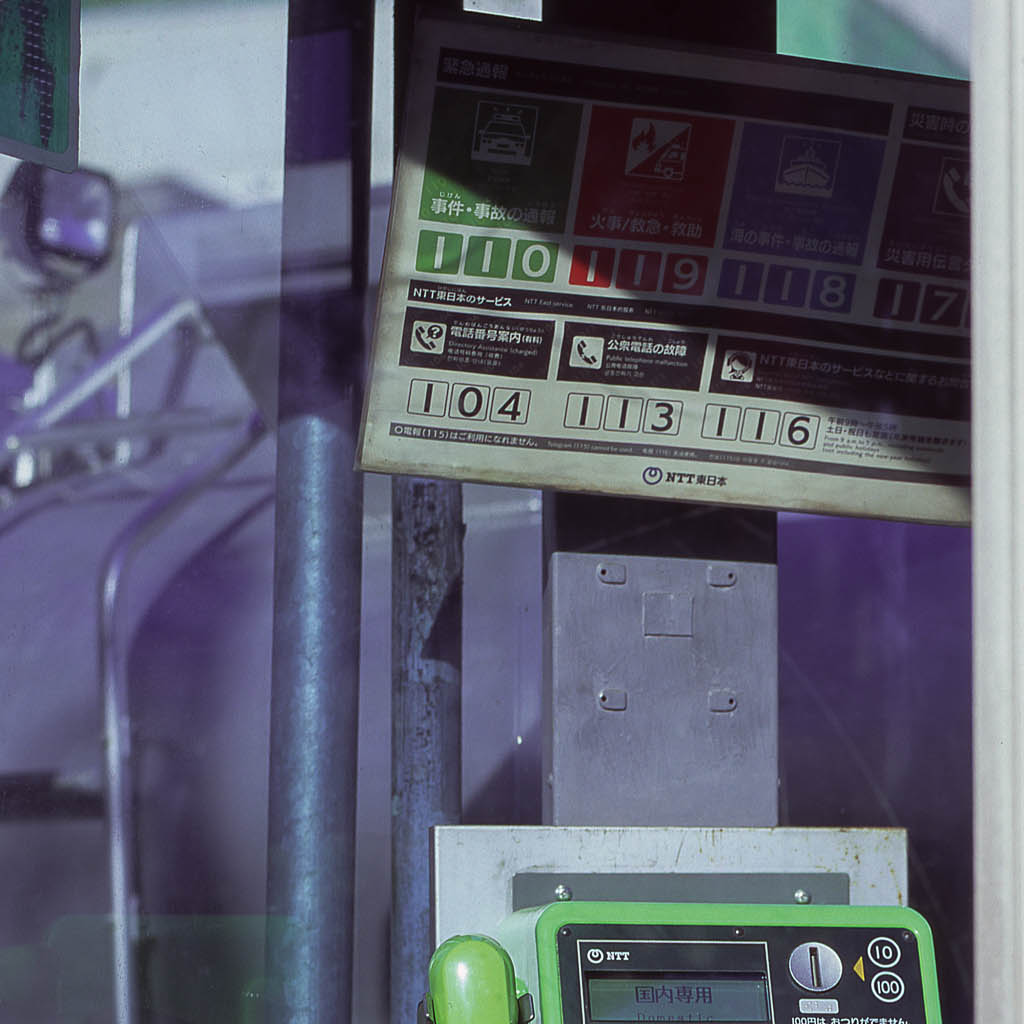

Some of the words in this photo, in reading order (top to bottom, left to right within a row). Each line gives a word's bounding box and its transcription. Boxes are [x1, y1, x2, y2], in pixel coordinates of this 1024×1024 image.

[443, 56, 510, 81] 緊急通報
[431, 197, 557, 225] 事件・事故の通報
[434, 235, 551, 278] 110
[586, 250, 700, 291] 119
[413, 288, 513, 308] NTT東日本のサービス
[735, 264, 848, 307] 118
[607, 339, 687, 356] 公衆電話の故障
[423, 383, 521, 421] 104
[579, 396, 674, 432] 113
[716, 407, 810, 445] 116
[606, 952, 630, 961] NTT
[875, 945, 893, 960] 10
[635, 985, 713, 1004] 国内専用
[877, 980, 900, 994] 100
